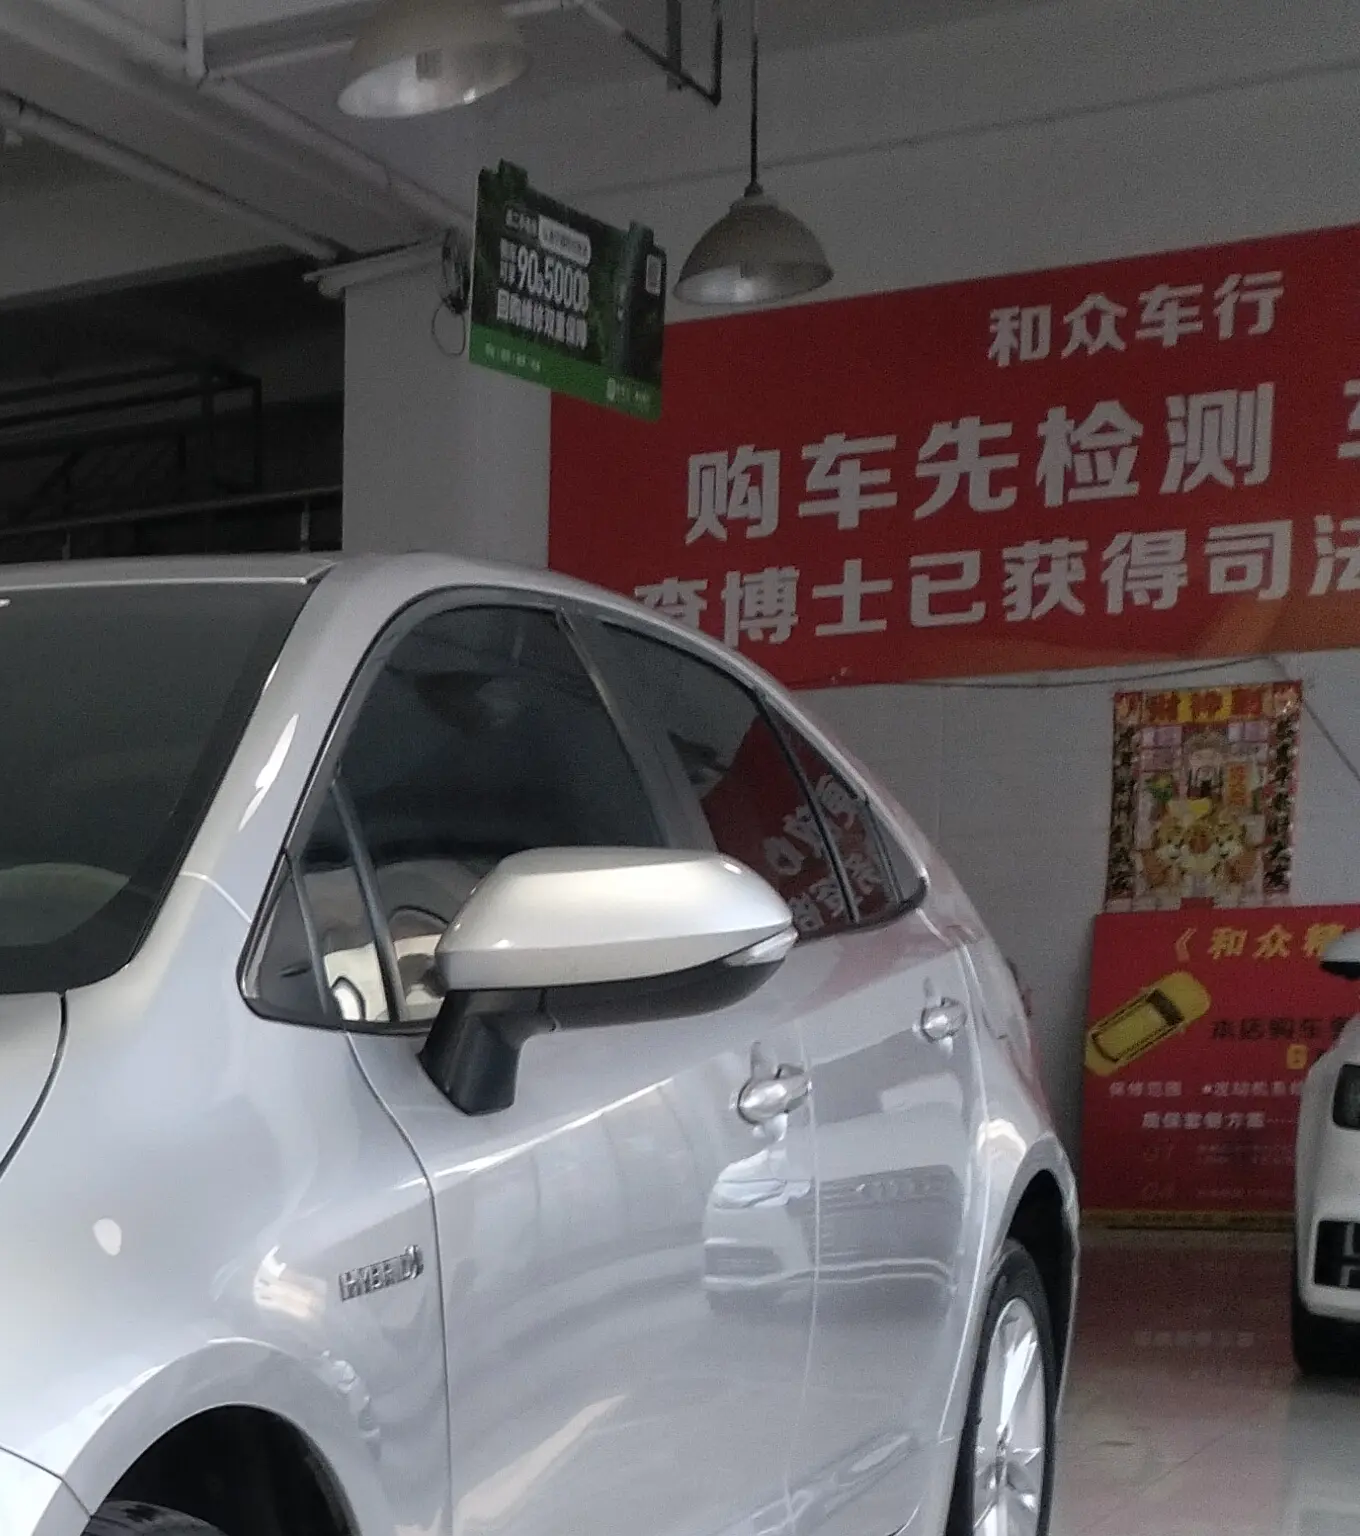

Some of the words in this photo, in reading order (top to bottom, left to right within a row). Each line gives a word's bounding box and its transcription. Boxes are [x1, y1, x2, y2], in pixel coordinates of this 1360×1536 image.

[986, 270, 1285, 369] 和众车行
[684, 380, 1276, 546] 购车先检测
